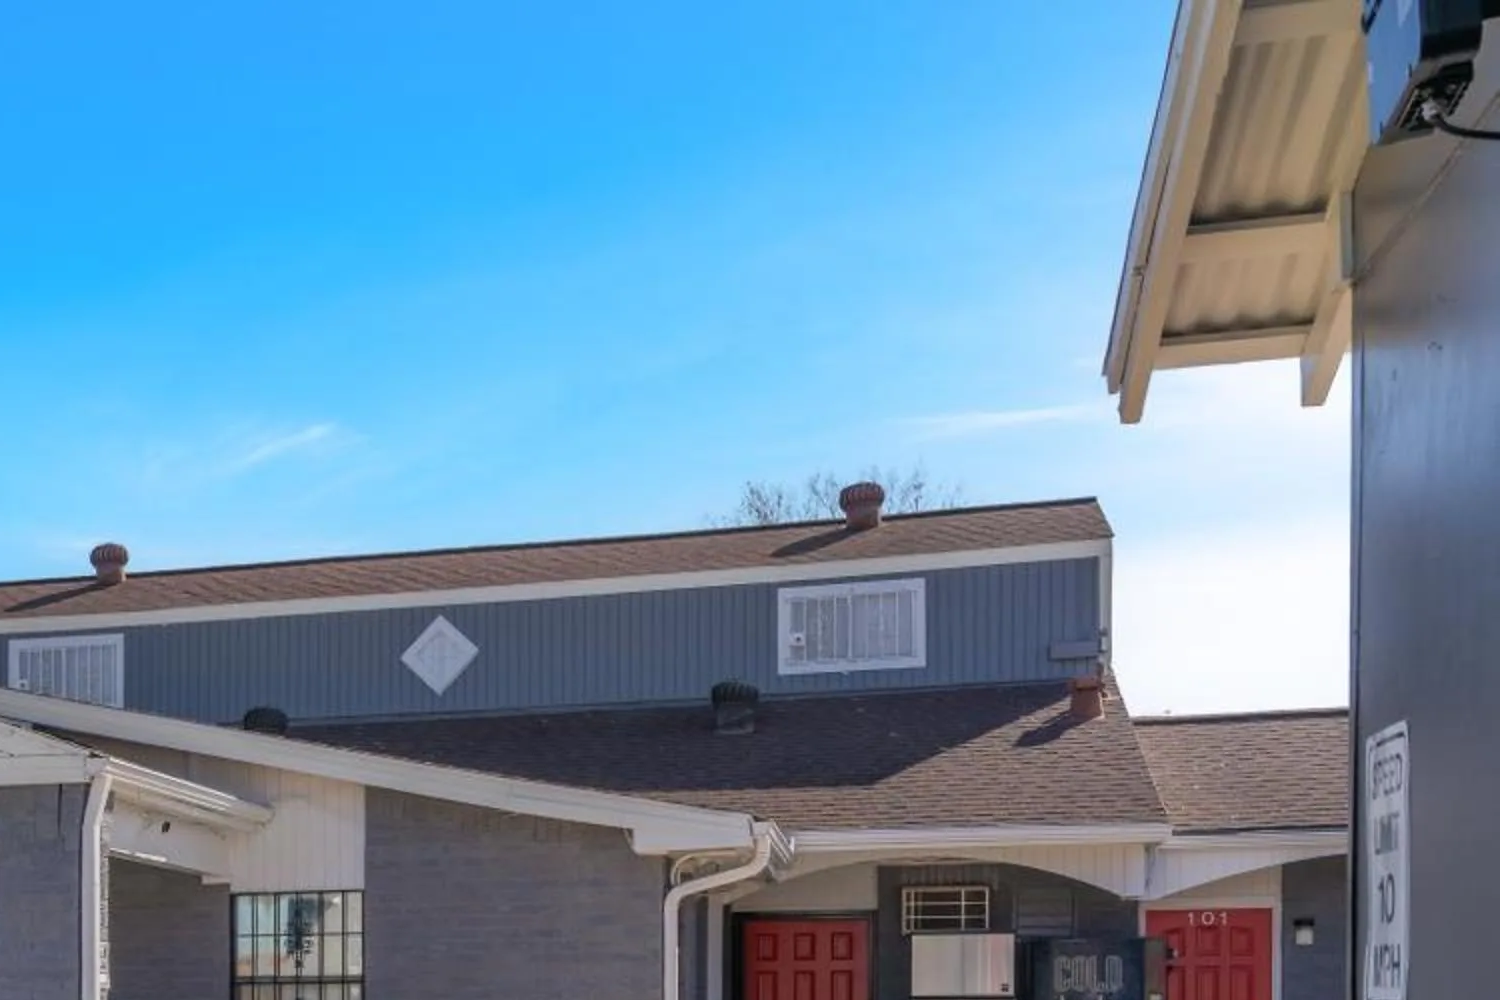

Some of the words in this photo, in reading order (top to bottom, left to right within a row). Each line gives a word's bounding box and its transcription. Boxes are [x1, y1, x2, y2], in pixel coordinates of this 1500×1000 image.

[1373, 752, 1404, 800] SPEED
[1373, 812, 1400, 855] LIMIT
[1187, 911, 1227, 926] 101
[1378, 873, 1396, 924] 10
[1053, 954, 1123, 993] COLD
[1373, 943, 1401, 988] MPH
